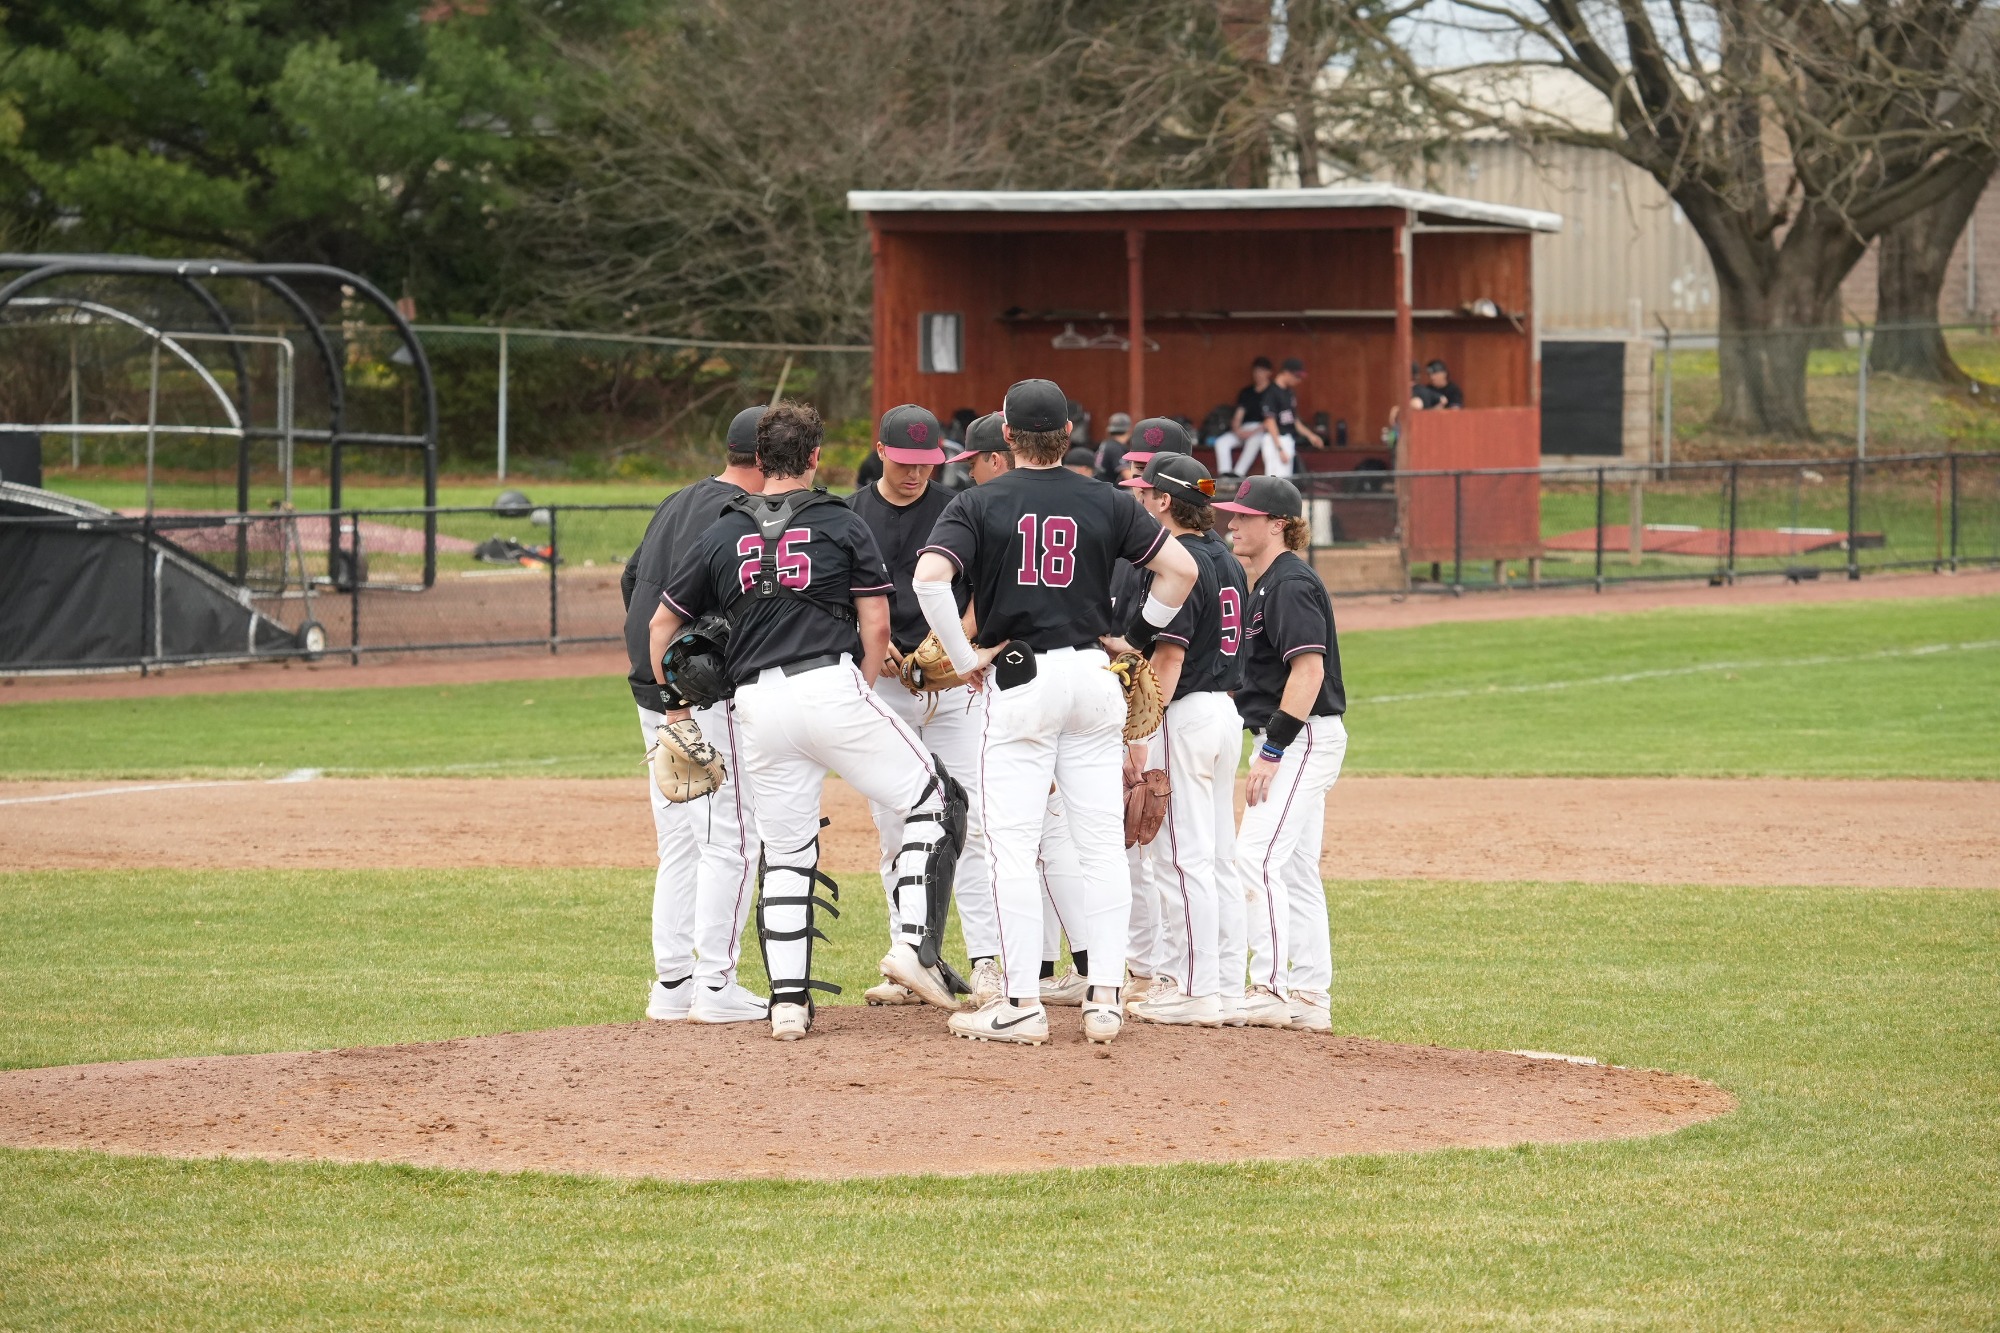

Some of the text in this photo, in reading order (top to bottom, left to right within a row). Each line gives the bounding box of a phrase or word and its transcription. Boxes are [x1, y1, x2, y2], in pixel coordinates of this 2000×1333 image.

[737, 528, 811, 595] 25
[1018, 513, 1078, 588] 18
[1219, 586, 1241, 656] 9
